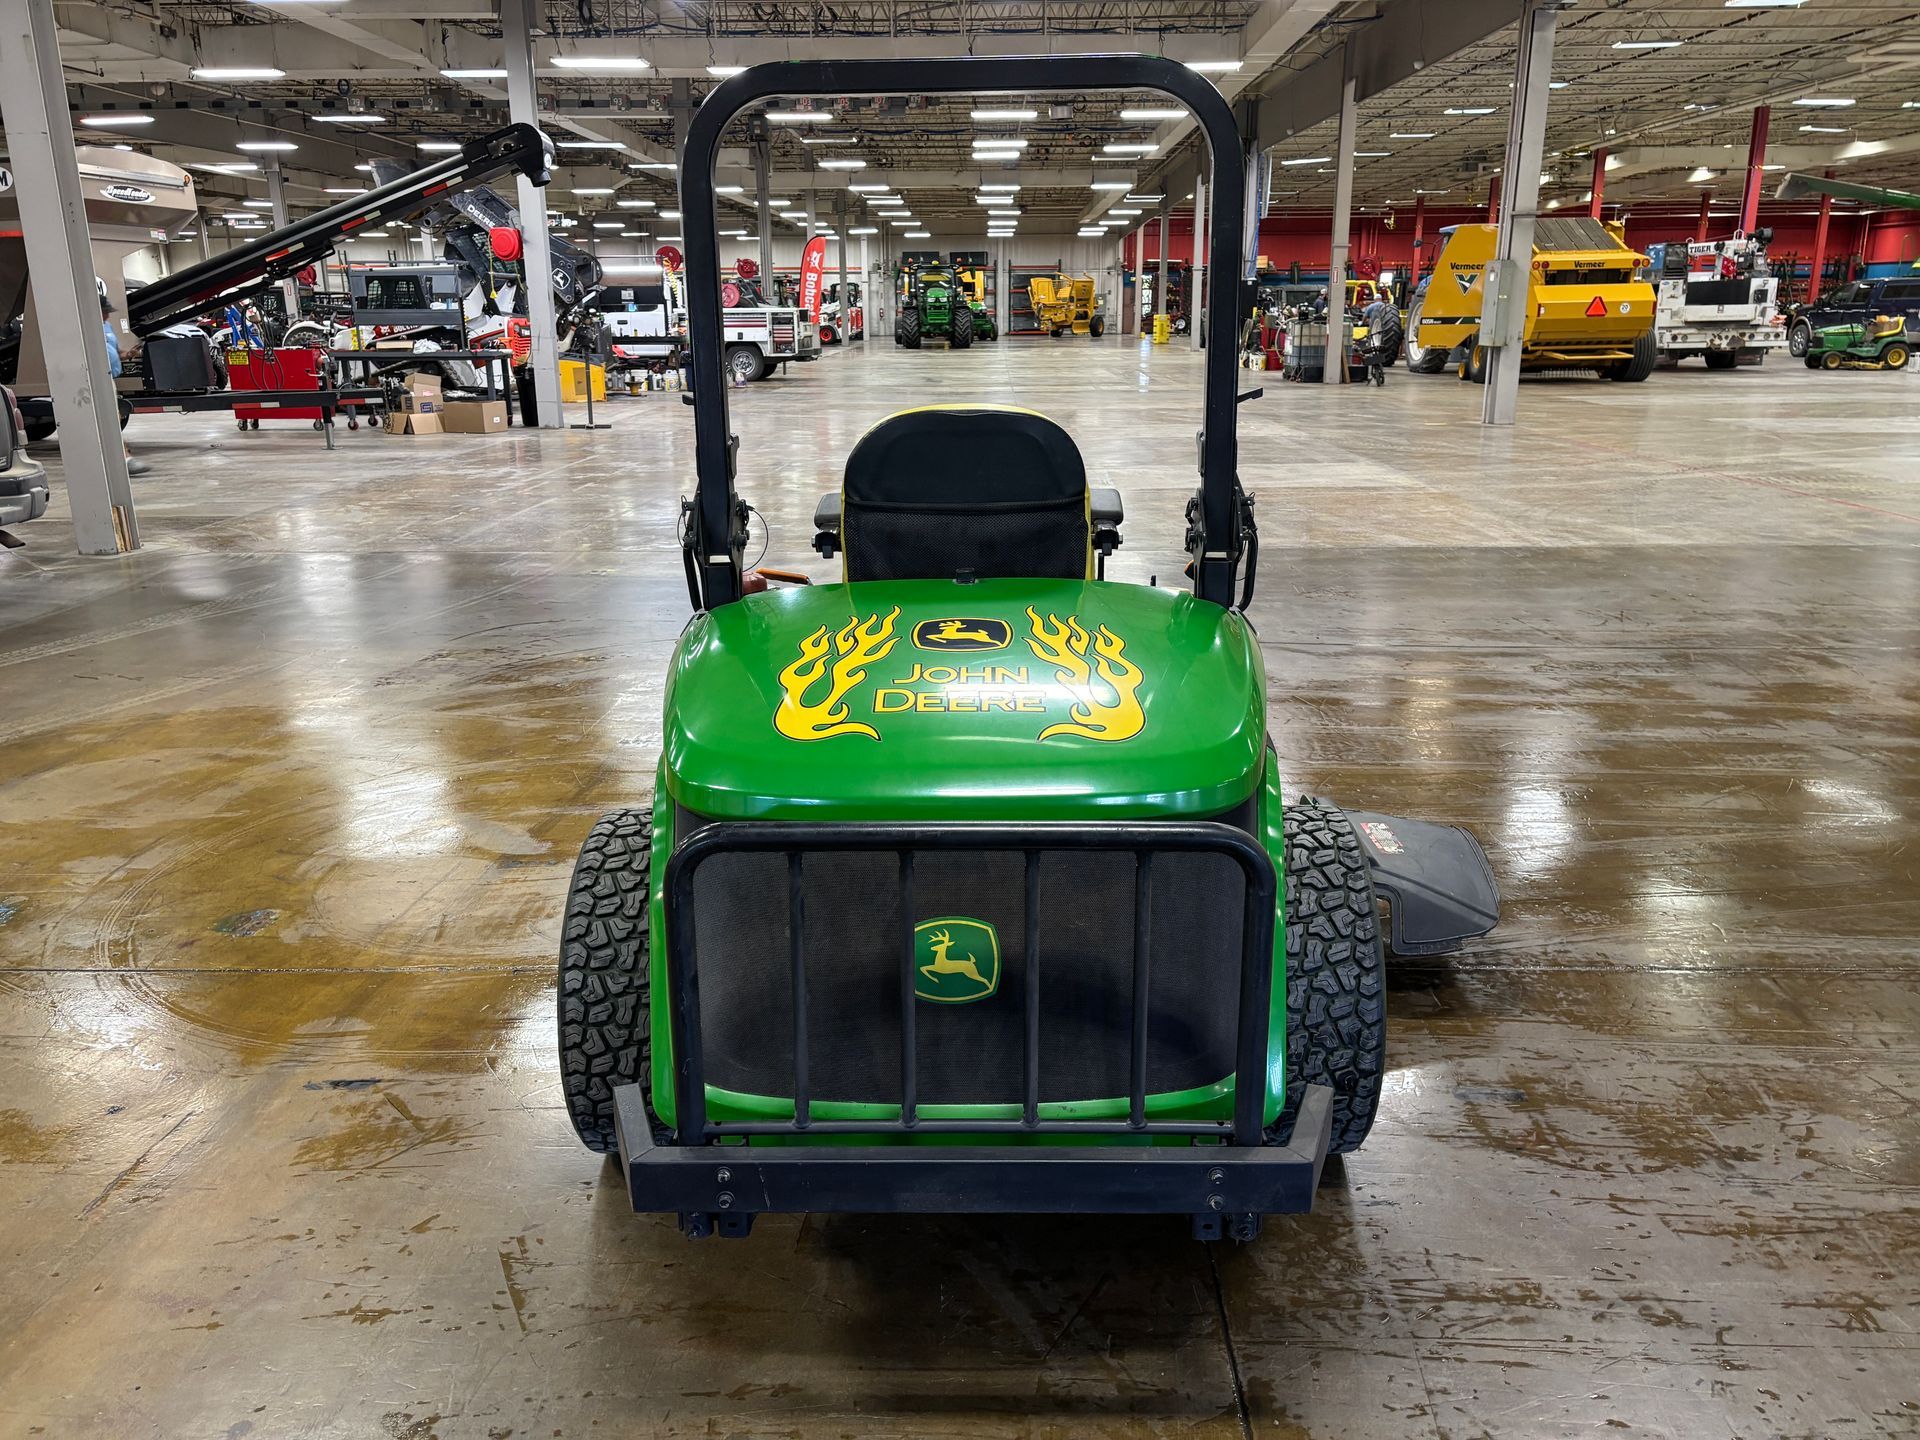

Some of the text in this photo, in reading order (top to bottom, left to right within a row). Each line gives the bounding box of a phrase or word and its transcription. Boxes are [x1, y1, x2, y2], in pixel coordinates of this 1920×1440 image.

[613, 97, 623, 106] 93
[650, 98, 661, 107] 95
[466, 203, 496, 229] DEERE
[1688, 244, 1711, 254] TIGER
[1449, 262, 1484, 271] Vermeer
[1574, 260, 1606, 269] Vermeer
[891, 662, 1030, 686] JOHN
[872, 688, 1047, 714] DEERE
